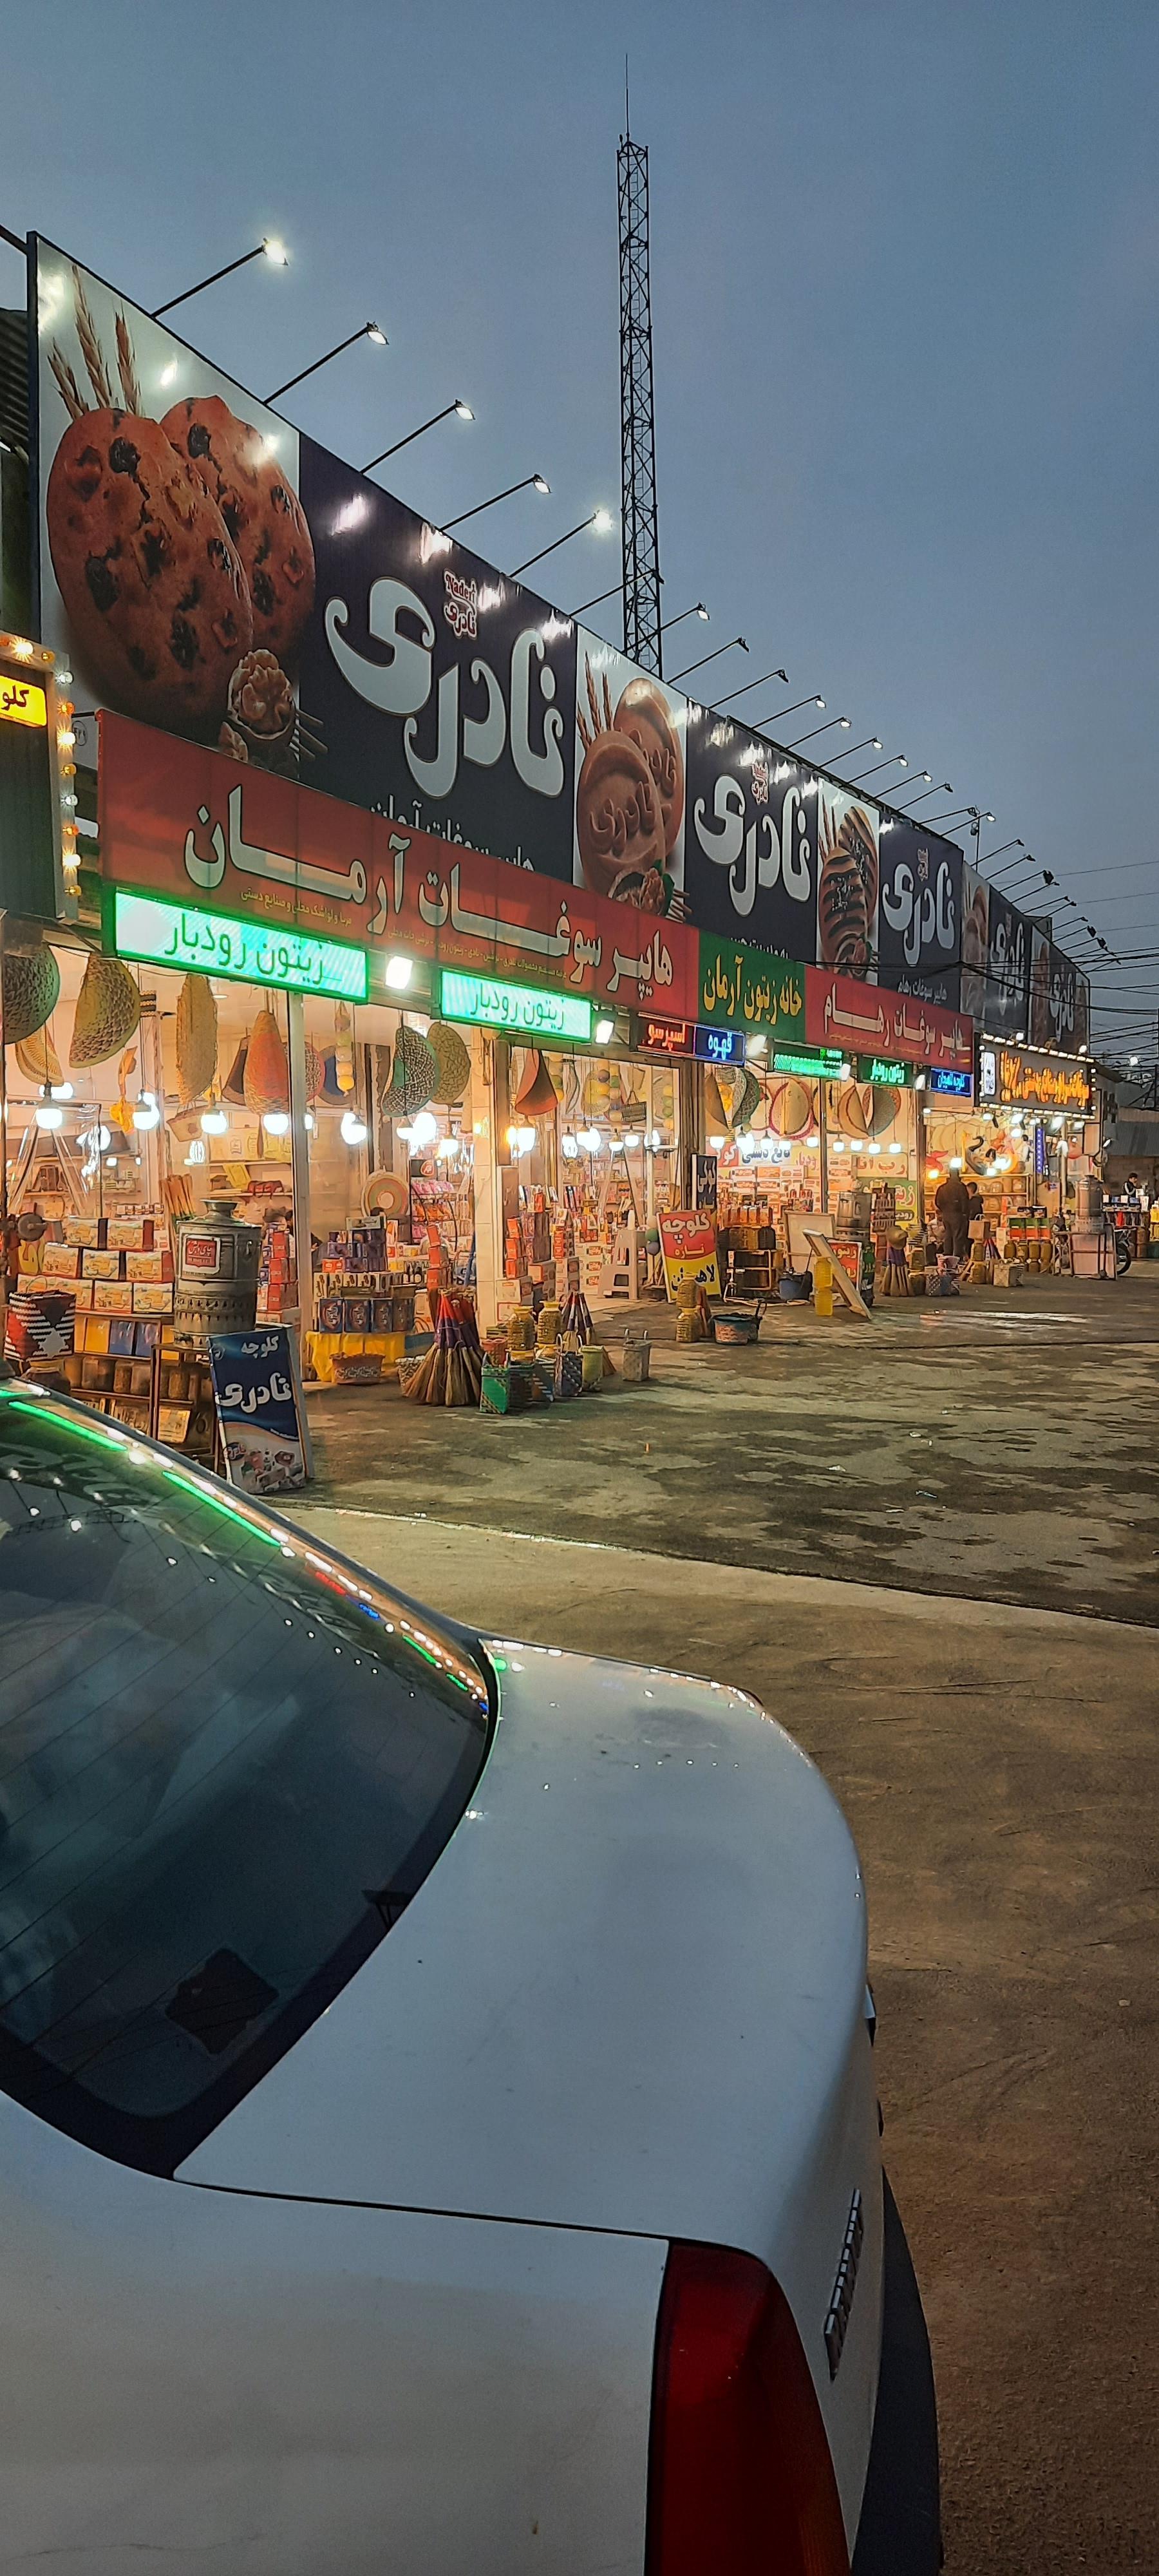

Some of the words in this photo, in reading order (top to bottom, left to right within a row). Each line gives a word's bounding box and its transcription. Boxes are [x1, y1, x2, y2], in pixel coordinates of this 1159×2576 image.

[445, 573, 476, 603] Naderi
[445, 604, 476, 635] نادری
[325, 576, 564, 799] نادری
[184, 784, 412, 937] آرمان
[694, 775, 811, 917] نادری
[241, 887, 263, 901] دستی
[265, 893, 286, 910] صنایع
[419, 861, 603, 984] سوغات
[882, 862, 956, 969] نادری
[164, 913, 248, 971] رودبار
[255, 937, 326, 985] زیتون
[608, 929, 672, 999] هایپر
[470, 983, 520, 1021] رودبار
[704, 954, 744, 1017] آرمان
[744, 974, 778, 1025] زیتون
[779, 974, 802, 1016] خانه
[522, 995, 566, 1031] زیتون
[824, 982, 890, 1047] رهام
[894, 1003, 936, 1055] سوغات
[648, 1023, 686, 1052] اسپرسو
[708, 1032, 733, 1061] قهوه
[938, 1019, 971, 1059] هایپر
[889, 1062, 905, 1084] زیتون
[661, 1212, 710, 1244] کلوچه
[674, 1243, 705, 1259] تازه
[240, 1334, 279, 1359] کلوچه
[216, 1372, 292, 1414] نادری
